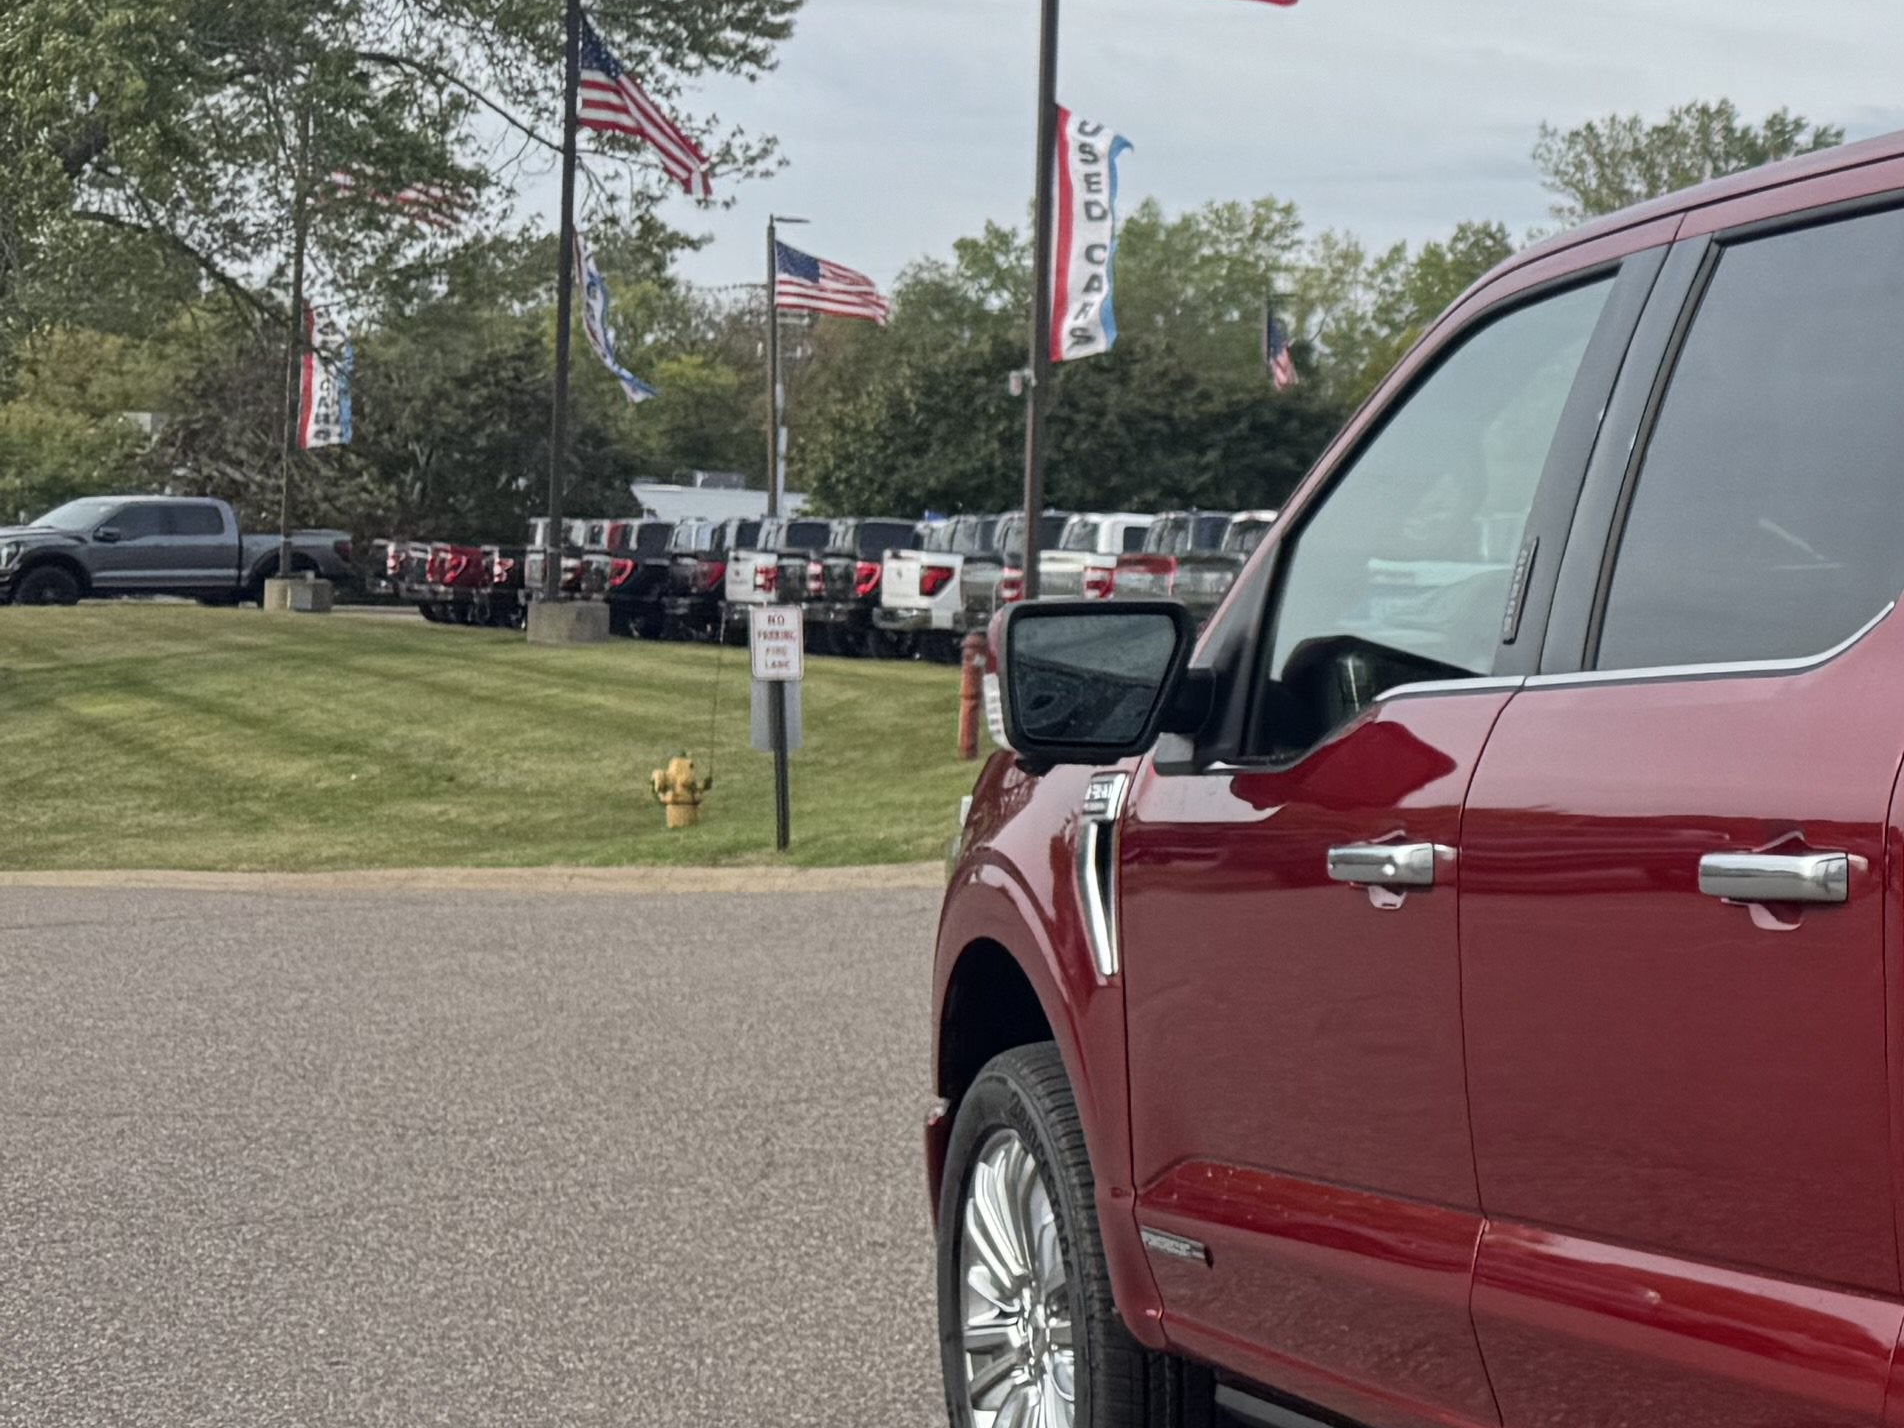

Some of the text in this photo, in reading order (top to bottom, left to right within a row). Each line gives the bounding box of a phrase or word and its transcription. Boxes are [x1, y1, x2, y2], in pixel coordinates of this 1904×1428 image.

[1066, 119, 1109, 351] USED CARS
[767, 614, 785, 626] NO
